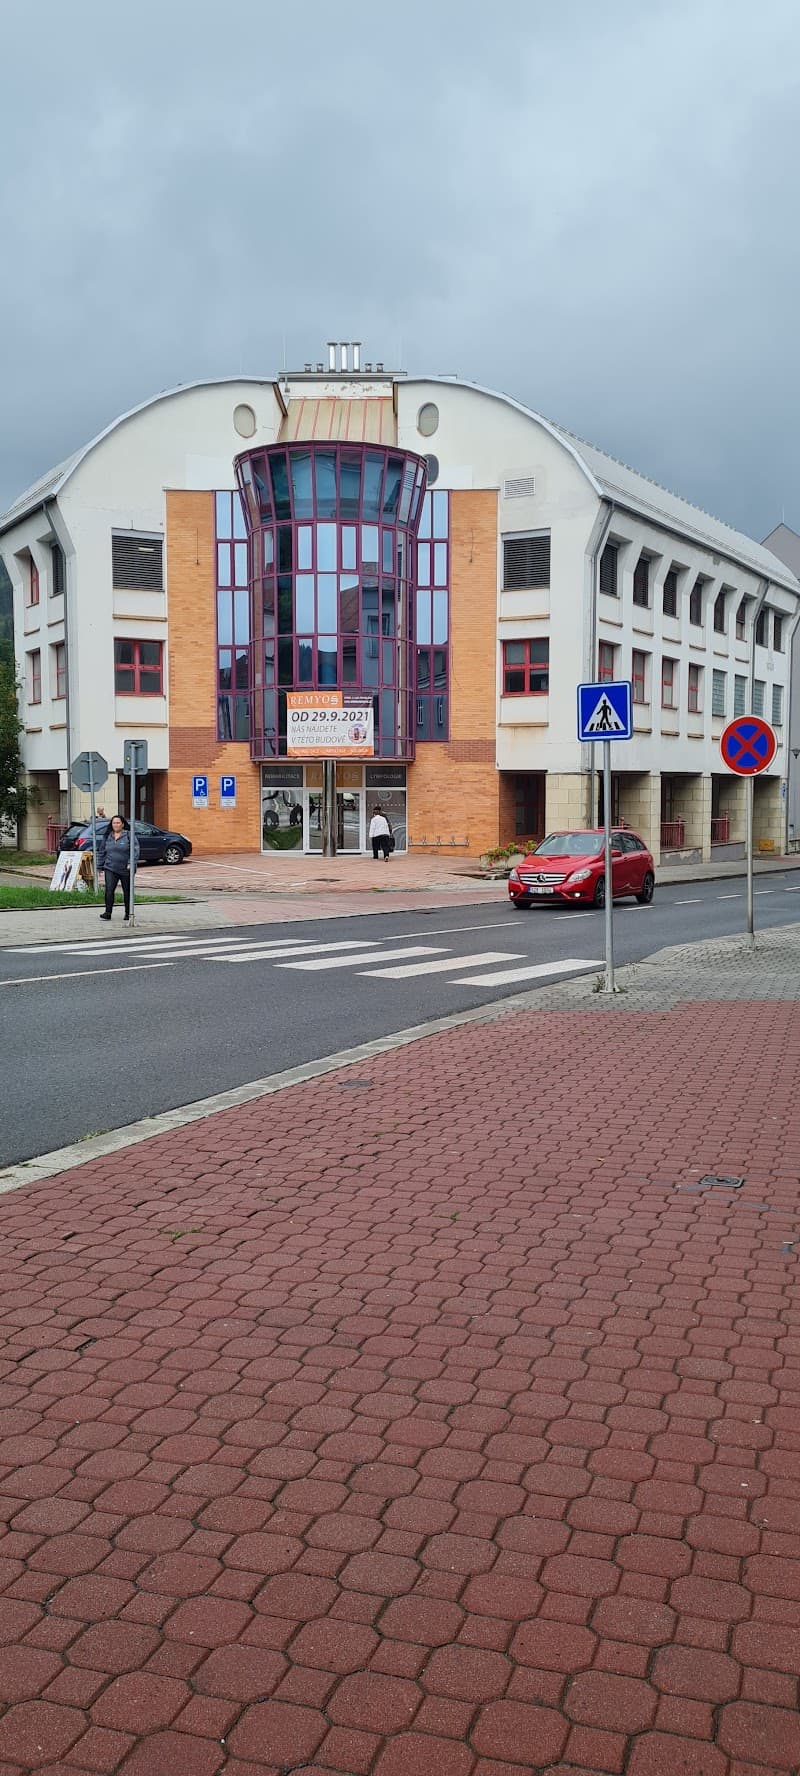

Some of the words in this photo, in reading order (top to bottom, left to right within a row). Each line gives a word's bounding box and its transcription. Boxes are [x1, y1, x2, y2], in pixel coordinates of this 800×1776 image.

[290, 695, 338, 705] REMYOS
[291, 711, 309, 722] OD
[311, 711, 369, 722] 29.9.2021
[306, 725, 338, 733] NAJDETE
[195, 778, 205, 792] P
[223, 778, 233, 792] P
